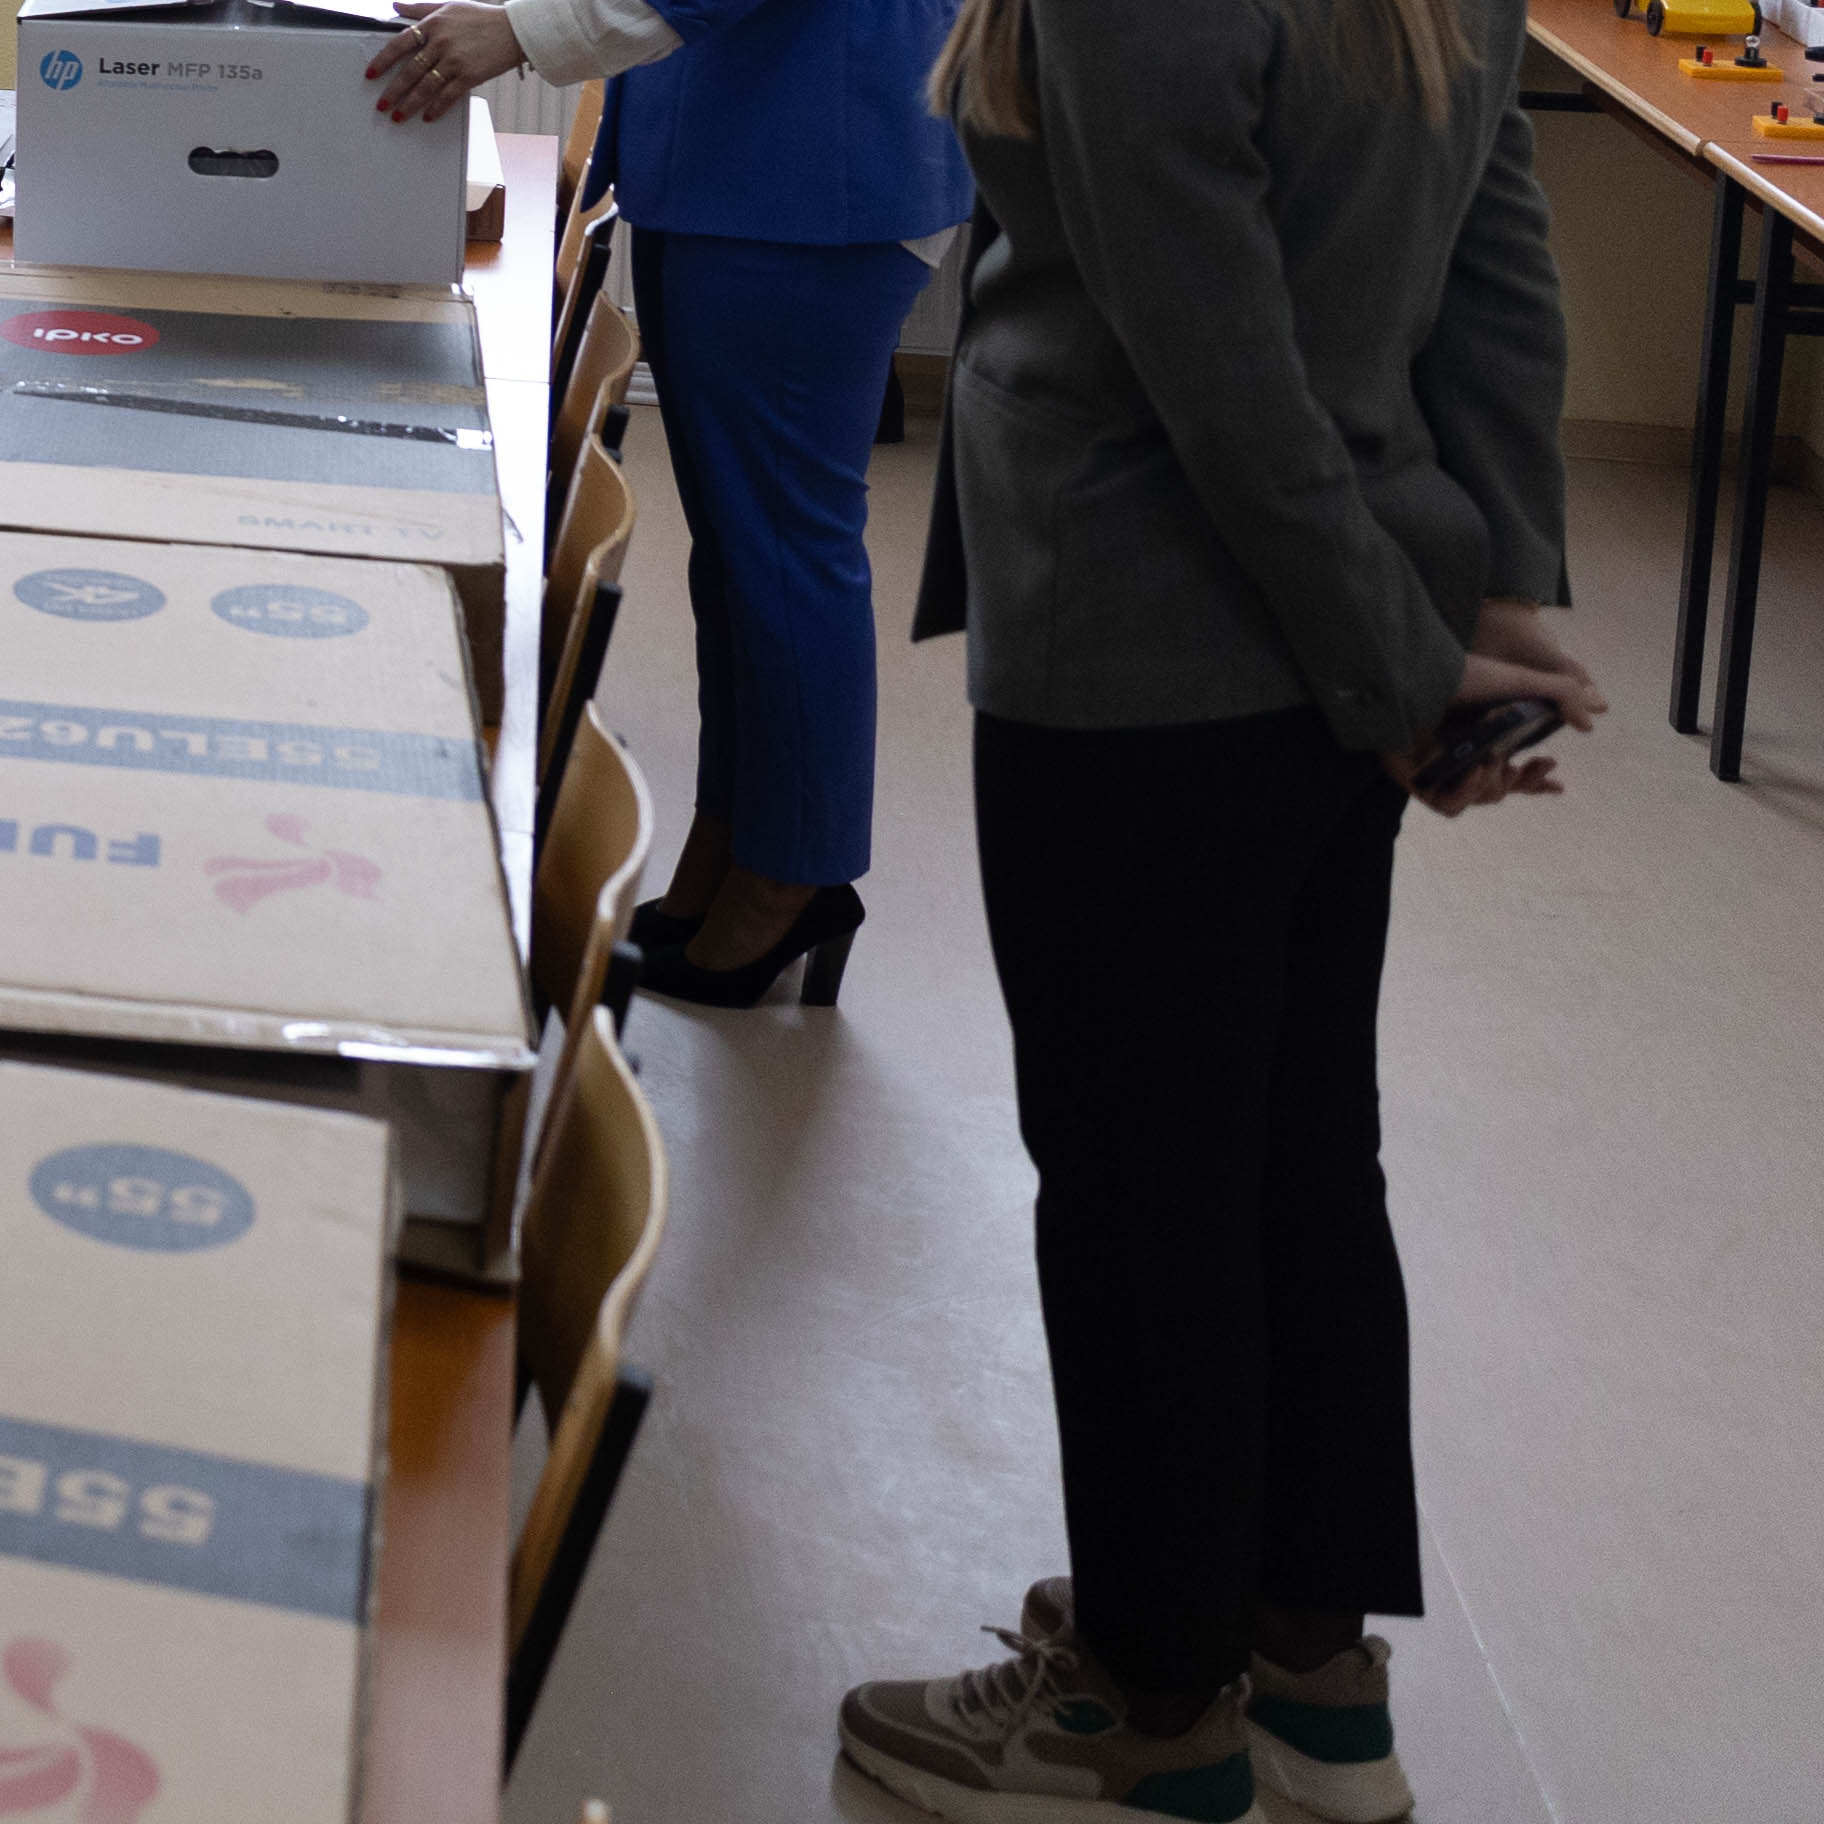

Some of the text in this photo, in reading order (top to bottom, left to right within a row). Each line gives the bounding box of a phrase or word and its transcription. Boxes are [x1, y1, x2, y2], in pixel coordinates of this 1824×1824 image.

[40, 49, 83, 91] hp
[99, 57, 160, 76] Laser
[167, 62, 210, 78] MFP
[217, 64, 263, 80] 135a
